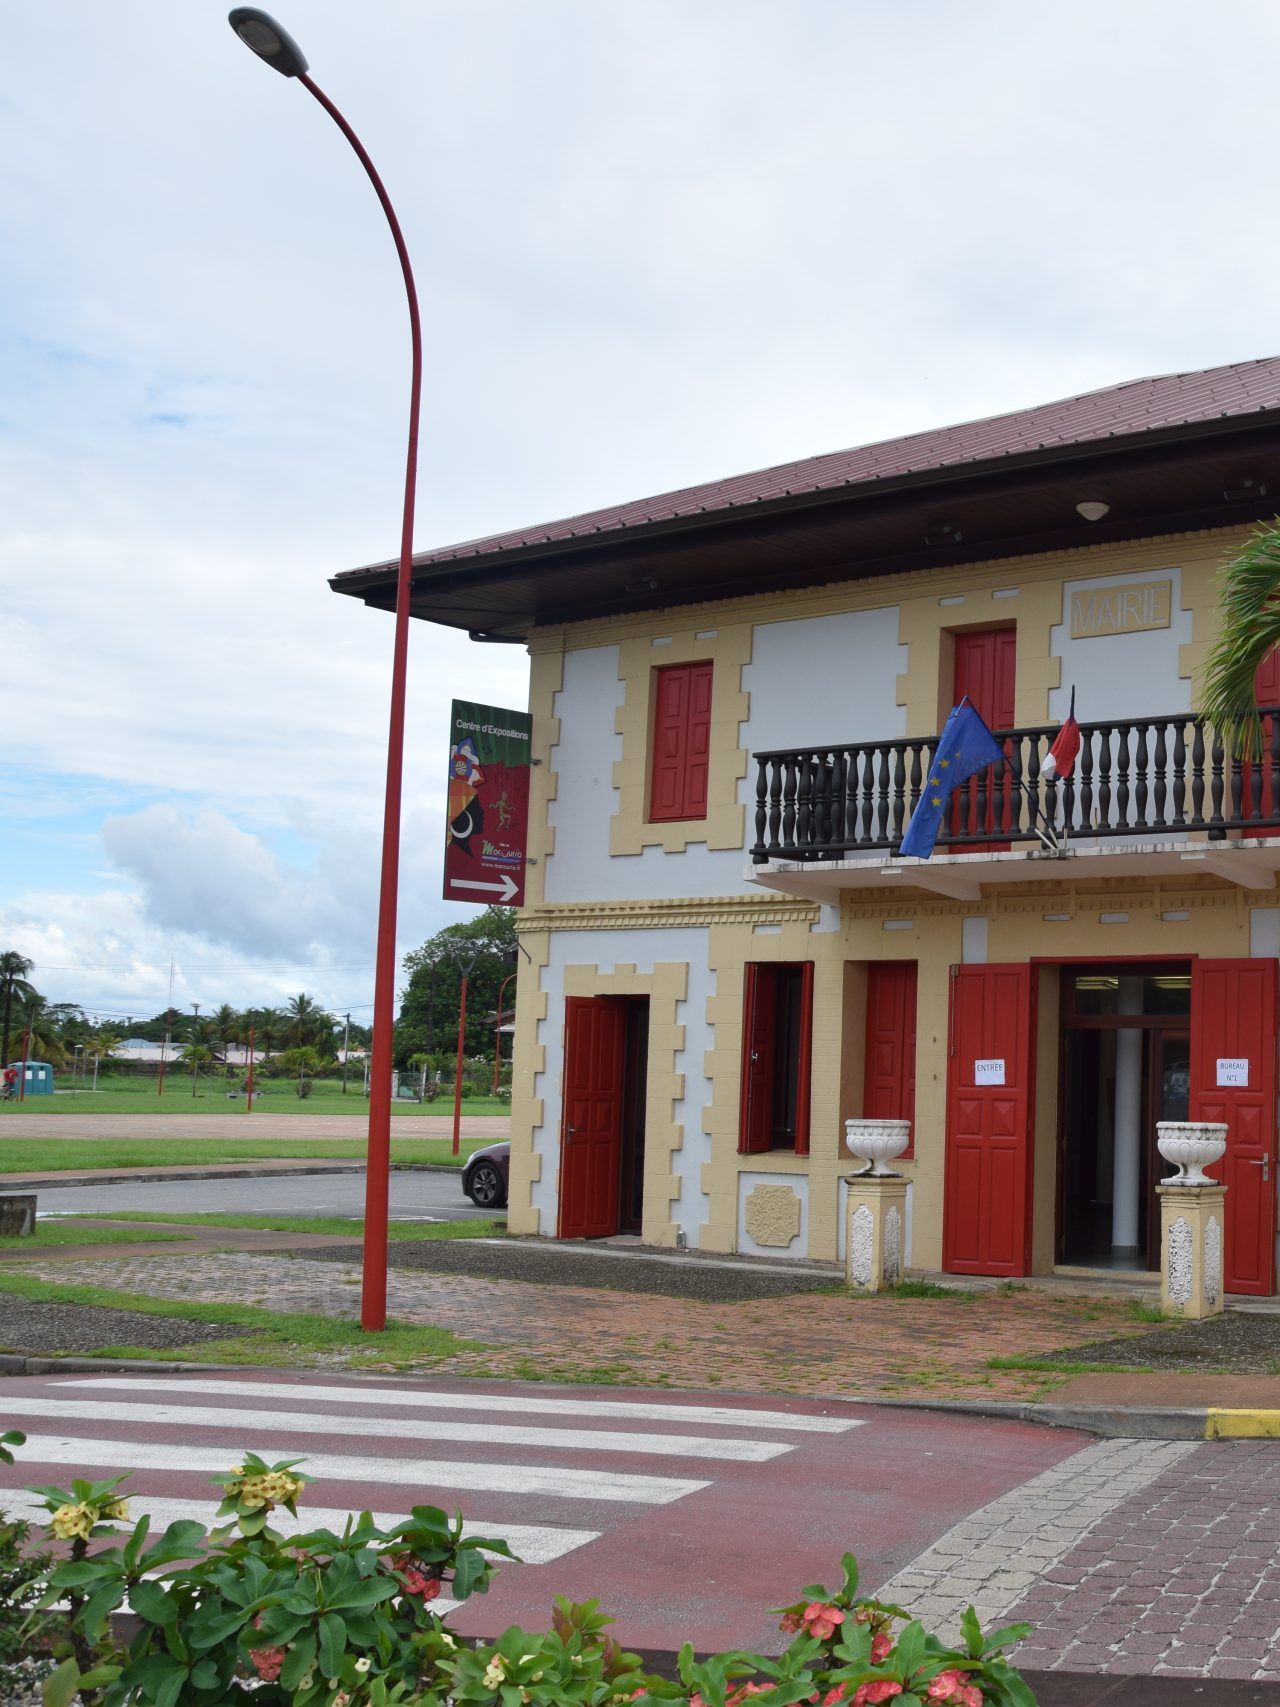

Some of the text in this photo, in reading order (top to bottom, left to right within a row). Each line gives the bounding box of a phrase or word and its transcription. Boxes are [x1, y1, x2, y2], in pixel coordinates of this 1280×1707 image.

[1073, 585, 1168, 632] MAIRIE
[456, 719, 529, 740] Centre d'Expositions
[977, 1063, 1003, 1071] ENTREE
[1220, 1062, 1245, 1070] BUREAU
